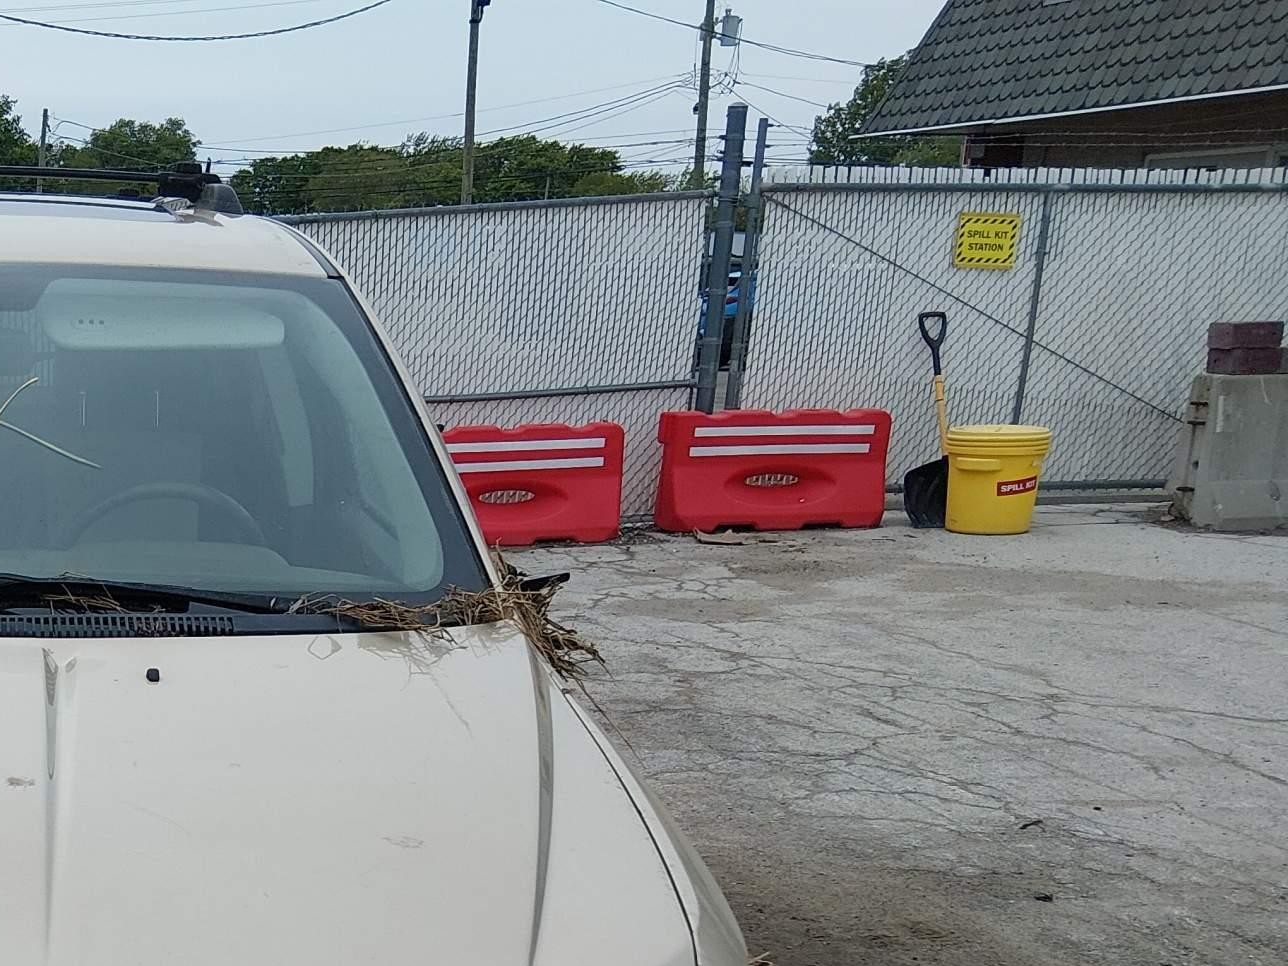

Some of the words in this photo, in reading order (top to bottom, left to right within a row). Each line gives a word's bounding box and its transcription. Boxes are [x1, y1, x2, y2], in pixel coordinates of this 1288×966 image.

[967, 230, 991, 239] SPILL
[994, 231, 1010, 240] KIT
[967, 243, 1004, 252] STATION
[1000, 483, 1025, 493] SPILL
